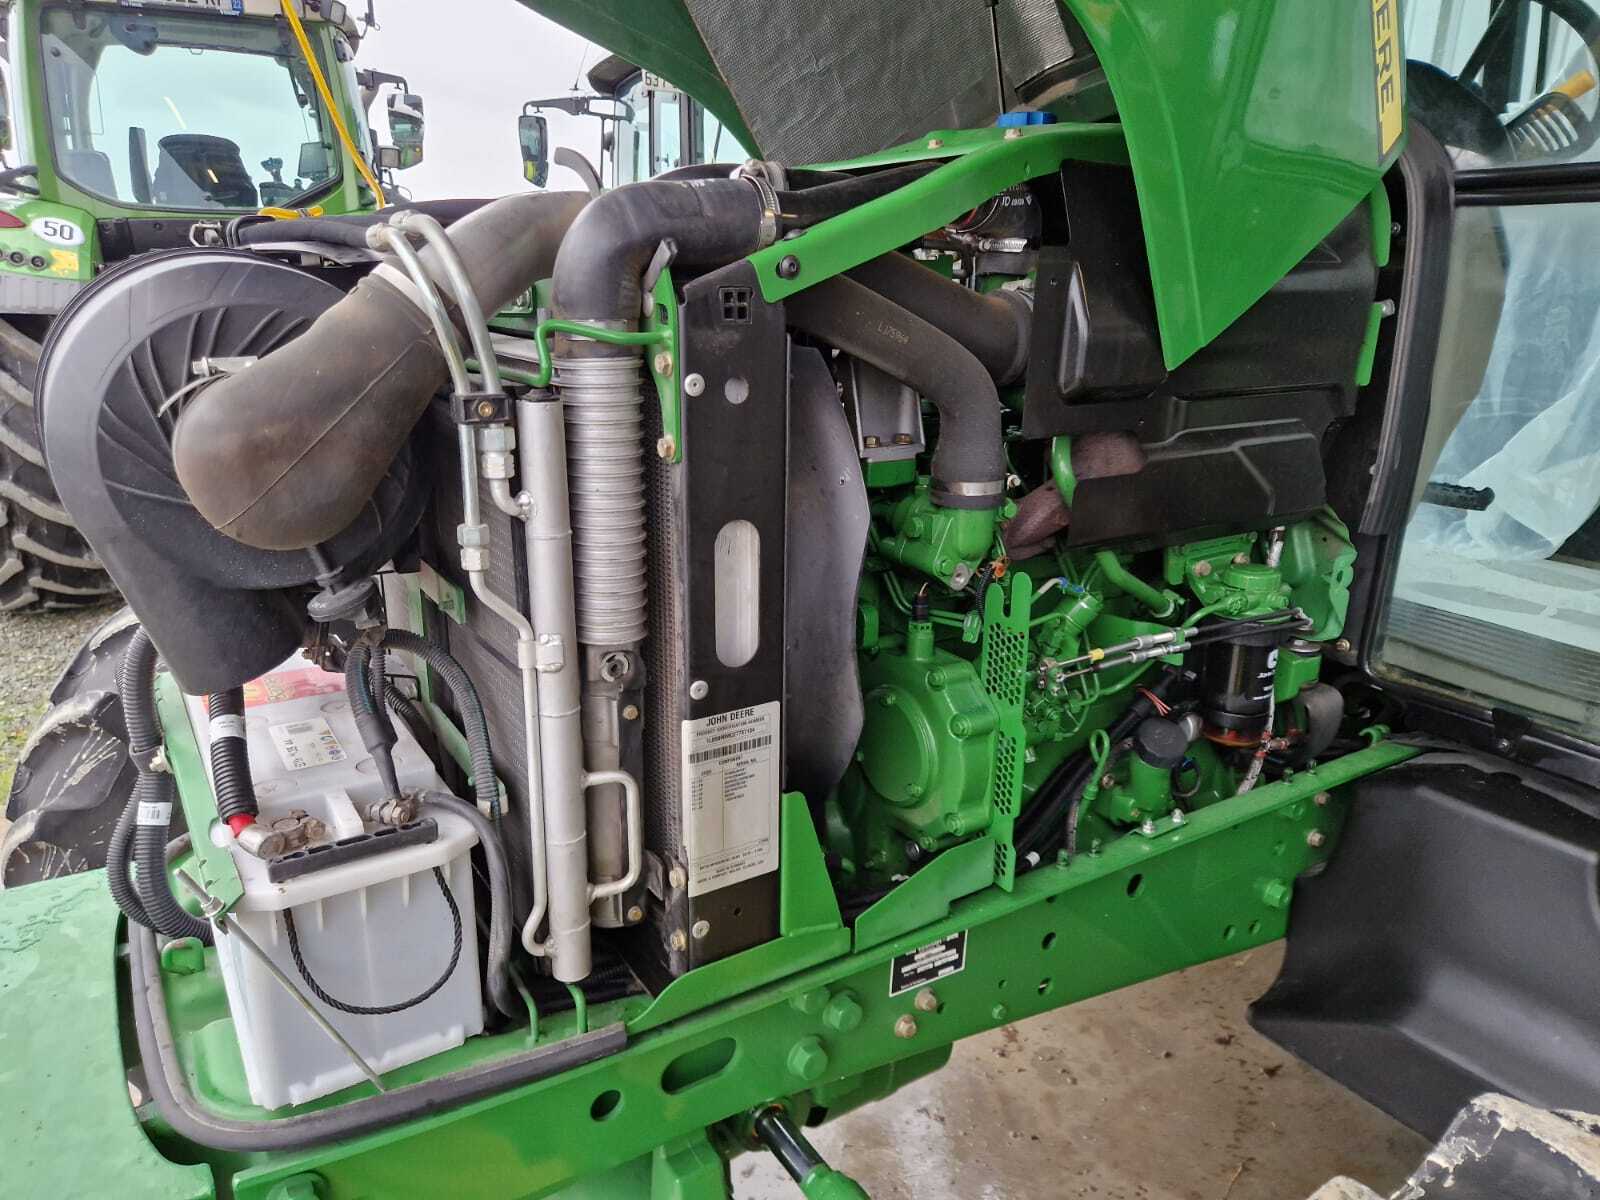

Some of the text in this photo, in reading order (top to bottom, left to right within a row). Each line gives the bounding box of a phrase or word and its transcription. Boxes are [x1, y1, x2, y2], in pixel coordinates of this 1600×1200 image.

[1376, 0, 1393, 114] ERE
[44, 221, 74, 240] 50
[706, 708, 754, 727] JOHN DEERE
